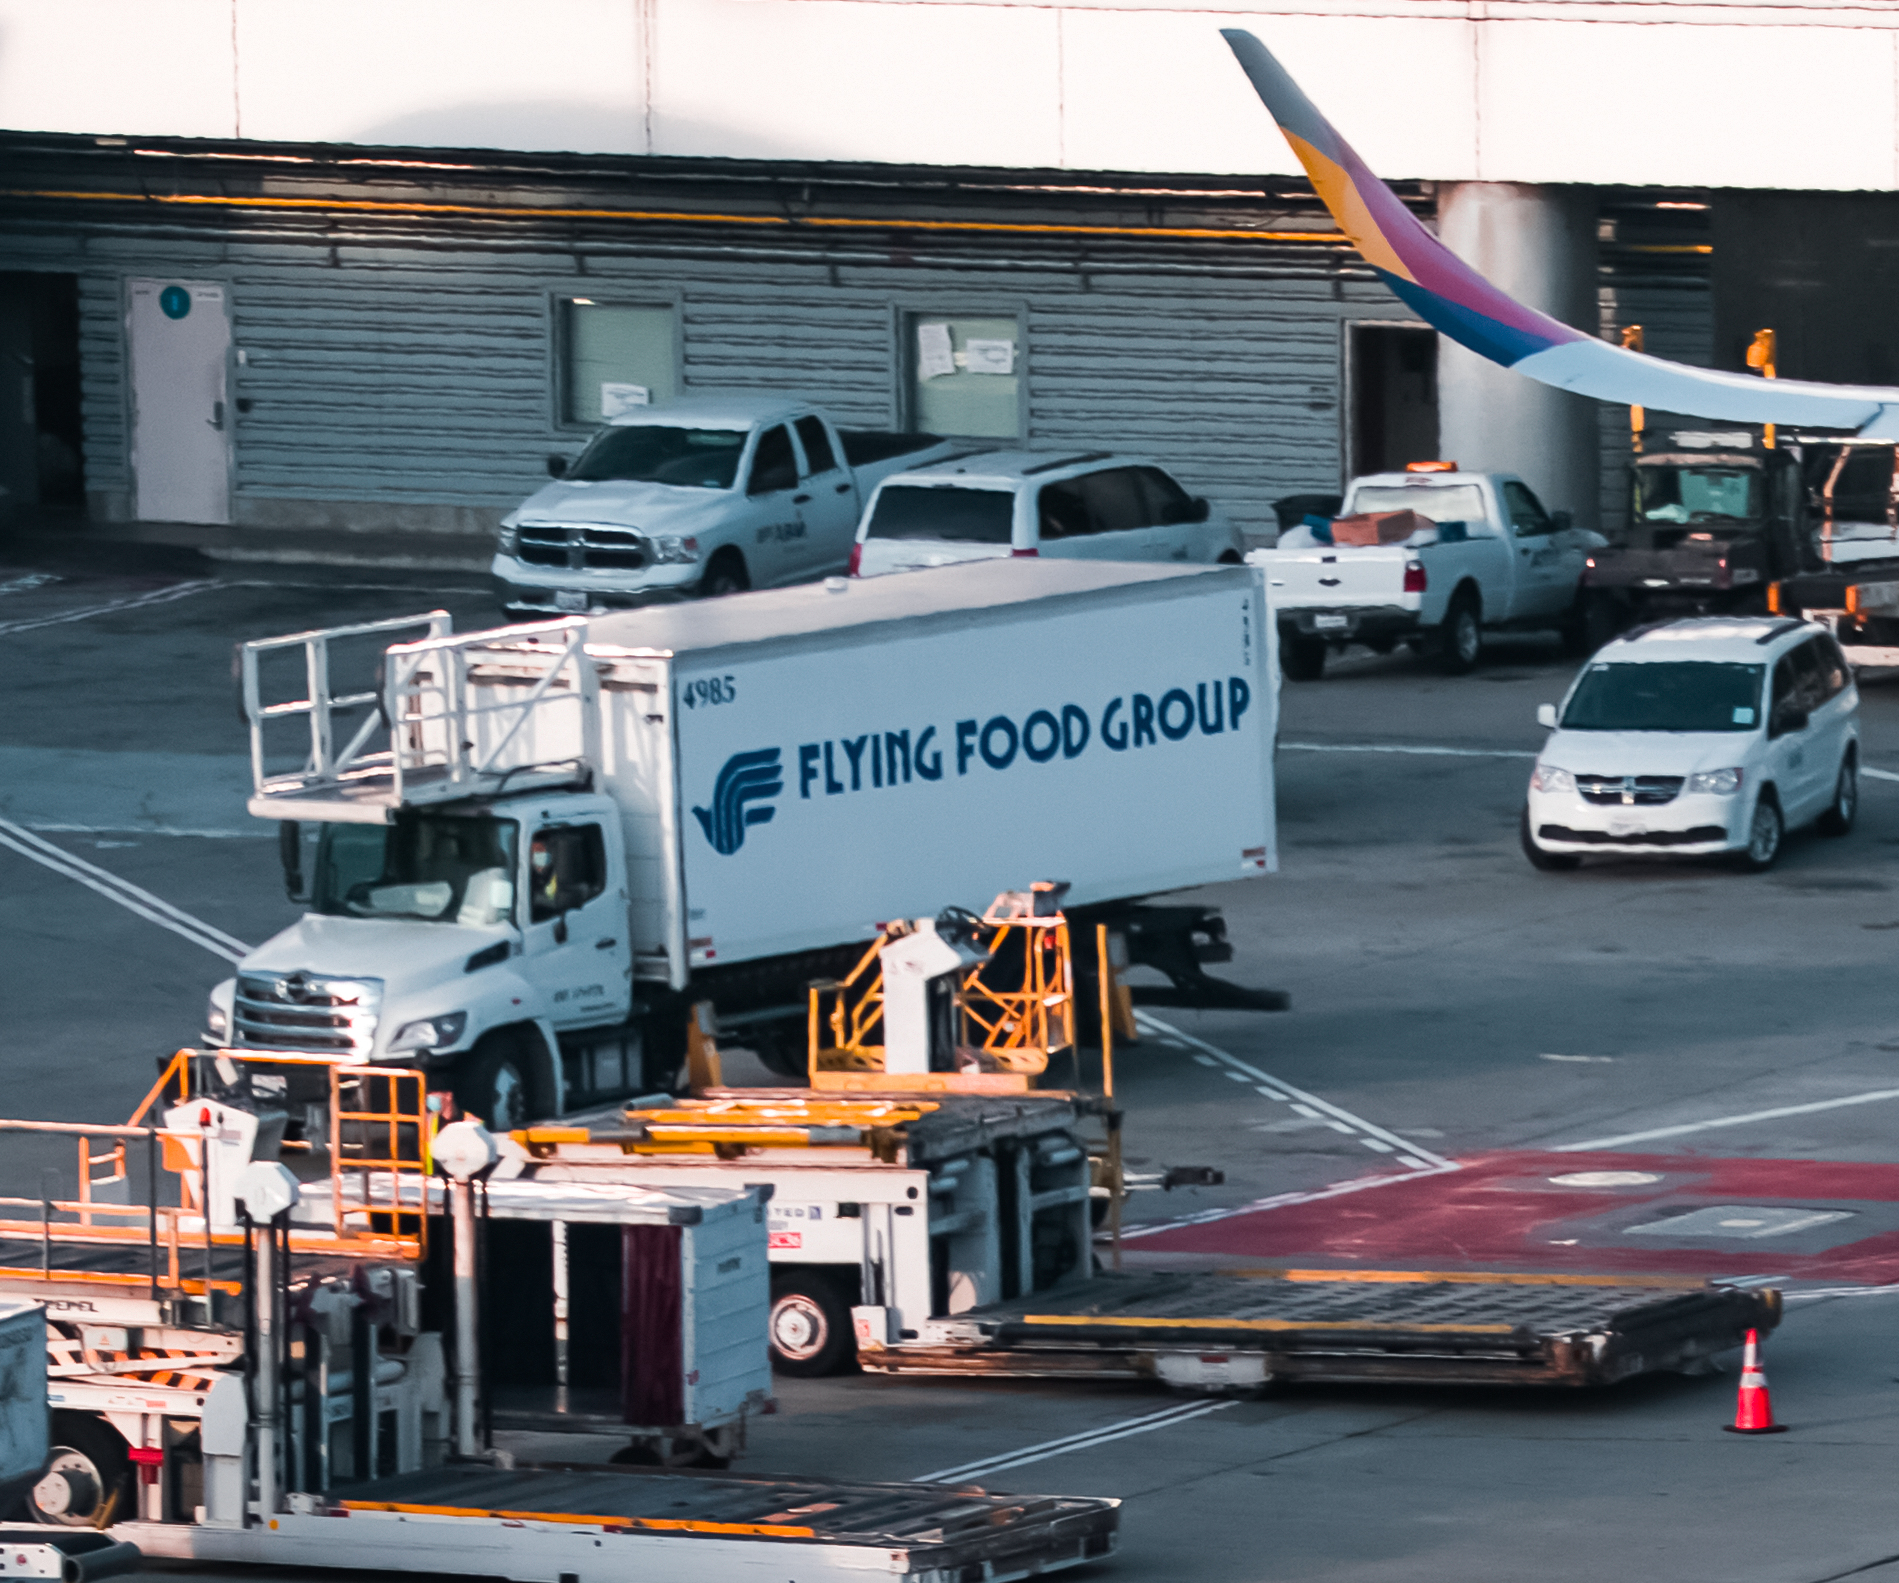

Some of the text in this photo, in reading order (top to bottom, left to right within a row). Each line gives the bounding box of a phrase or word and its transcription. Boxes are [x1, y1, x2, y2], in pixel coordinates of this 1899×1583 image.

[683, 675, 736, 709] 4985
[799, 676, 1250, 799] FLYING FOOD GROUP
